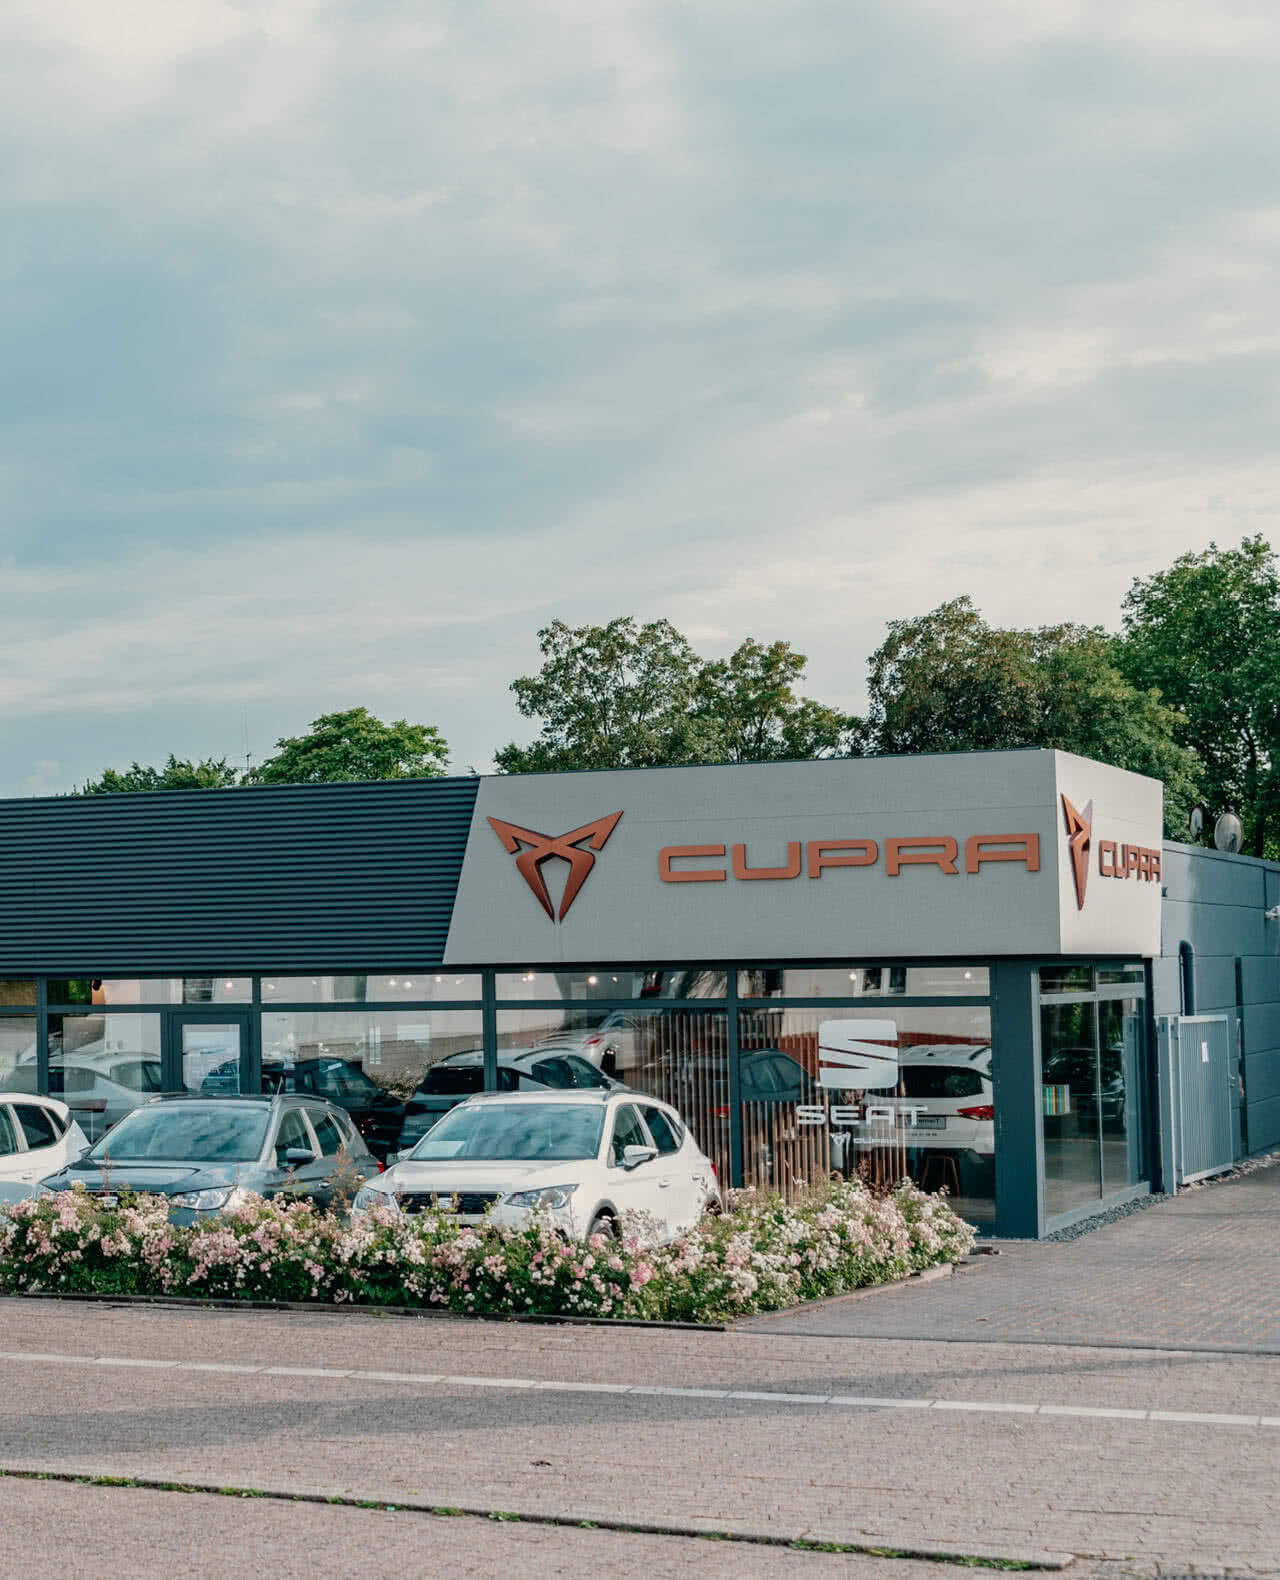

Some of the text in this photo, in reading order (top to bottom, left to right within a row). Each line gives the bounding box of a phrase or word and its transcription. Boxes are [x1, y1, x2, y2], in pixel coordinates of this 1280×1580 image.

[658, 832, 1041, 883] CUPRA
[1099, 840, 1161, 883] CUPRA
[796, 1105, 929, 1126] SEAT
